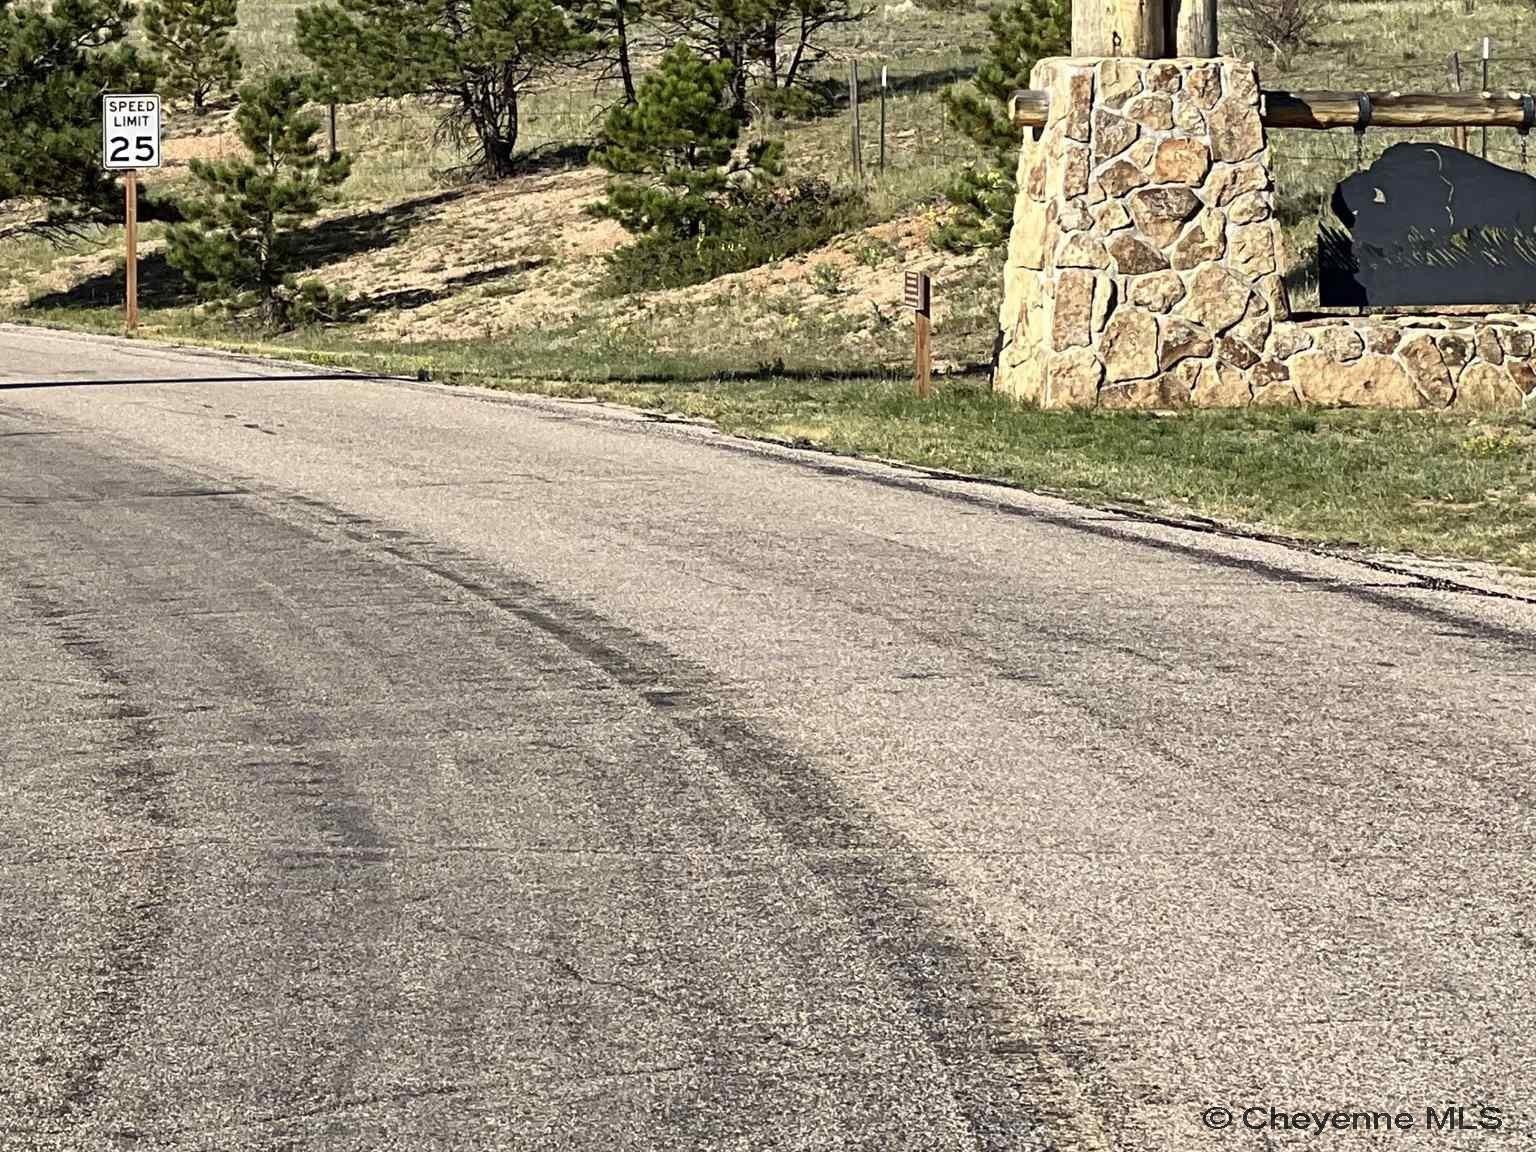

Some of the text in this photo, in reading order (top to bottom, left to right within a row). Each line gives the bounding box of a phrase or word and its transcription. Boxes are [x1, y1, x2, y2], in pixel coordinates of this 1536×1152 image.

[109, 101, 155, 112] SPEED
[114, 115, 149, 127] LIMIT
[110, 136, 154, 161] 25
